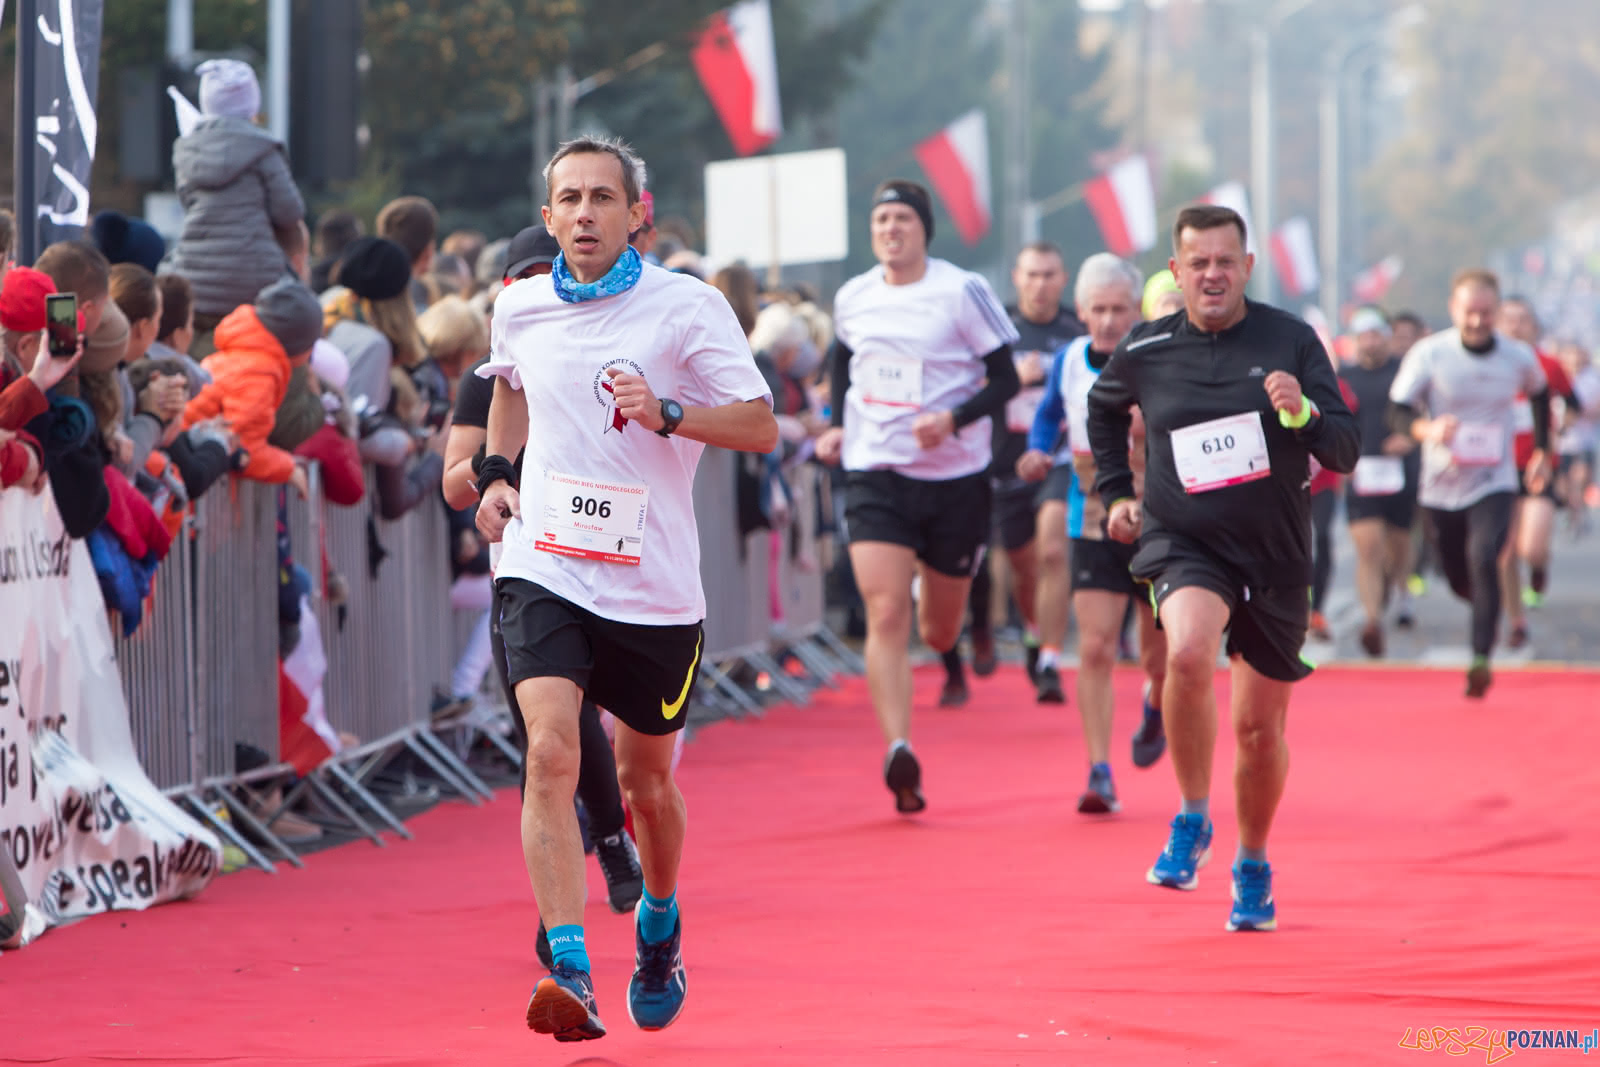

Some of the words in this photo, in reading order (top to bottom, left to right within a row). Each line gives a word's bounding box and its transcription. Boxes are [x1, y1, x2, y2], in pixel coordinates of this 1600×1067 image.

[602, 359, 629, 371] KOMITET
[1202, 434, 1236, 455] 610
[581, 481, 594, 489] BIEG
[571, 496, 612, 519] 906
[573, 521, 604, 532] Mirosław
